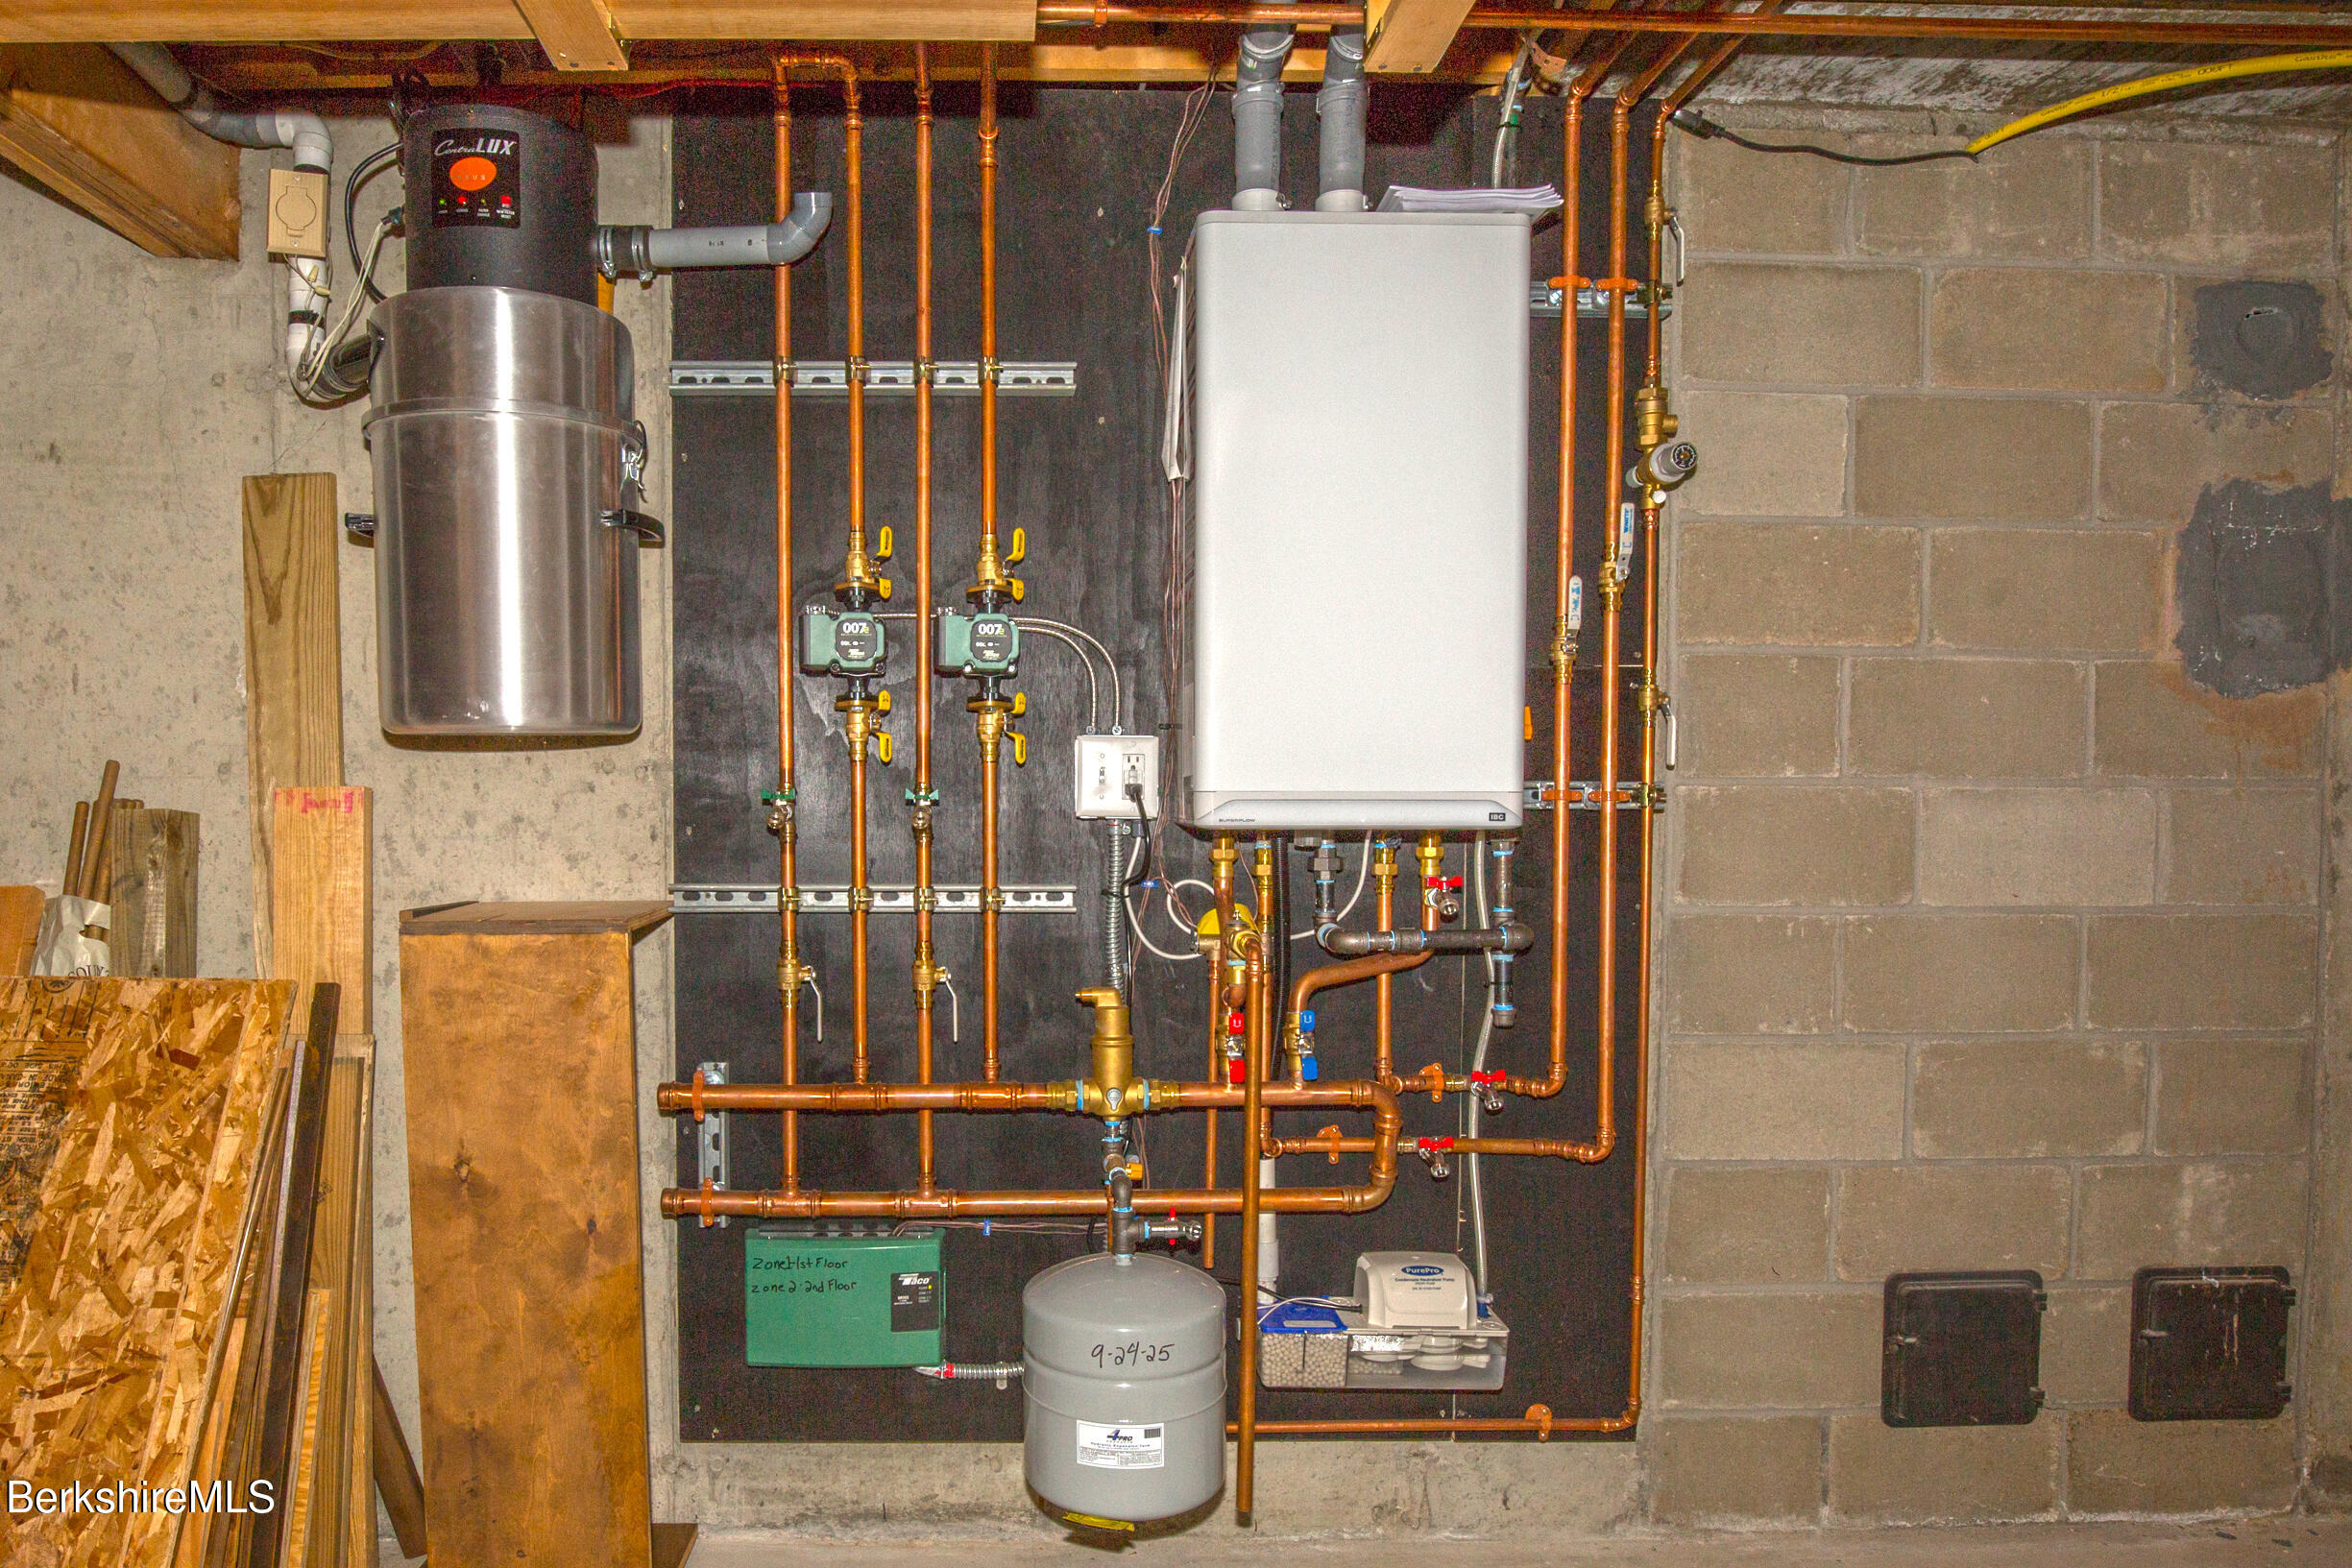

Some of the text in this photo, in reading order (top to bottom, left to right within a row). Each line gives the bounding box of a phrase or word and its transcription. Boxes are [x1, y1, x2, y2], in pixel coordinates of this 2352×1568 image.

[815, 1256, 849, 1268] Floor
[751, 1283, 786, 1293] zone
[828, 1278, 858, 1291] Floor
[1091, 1341, 1175, 1368] 9-24-25
